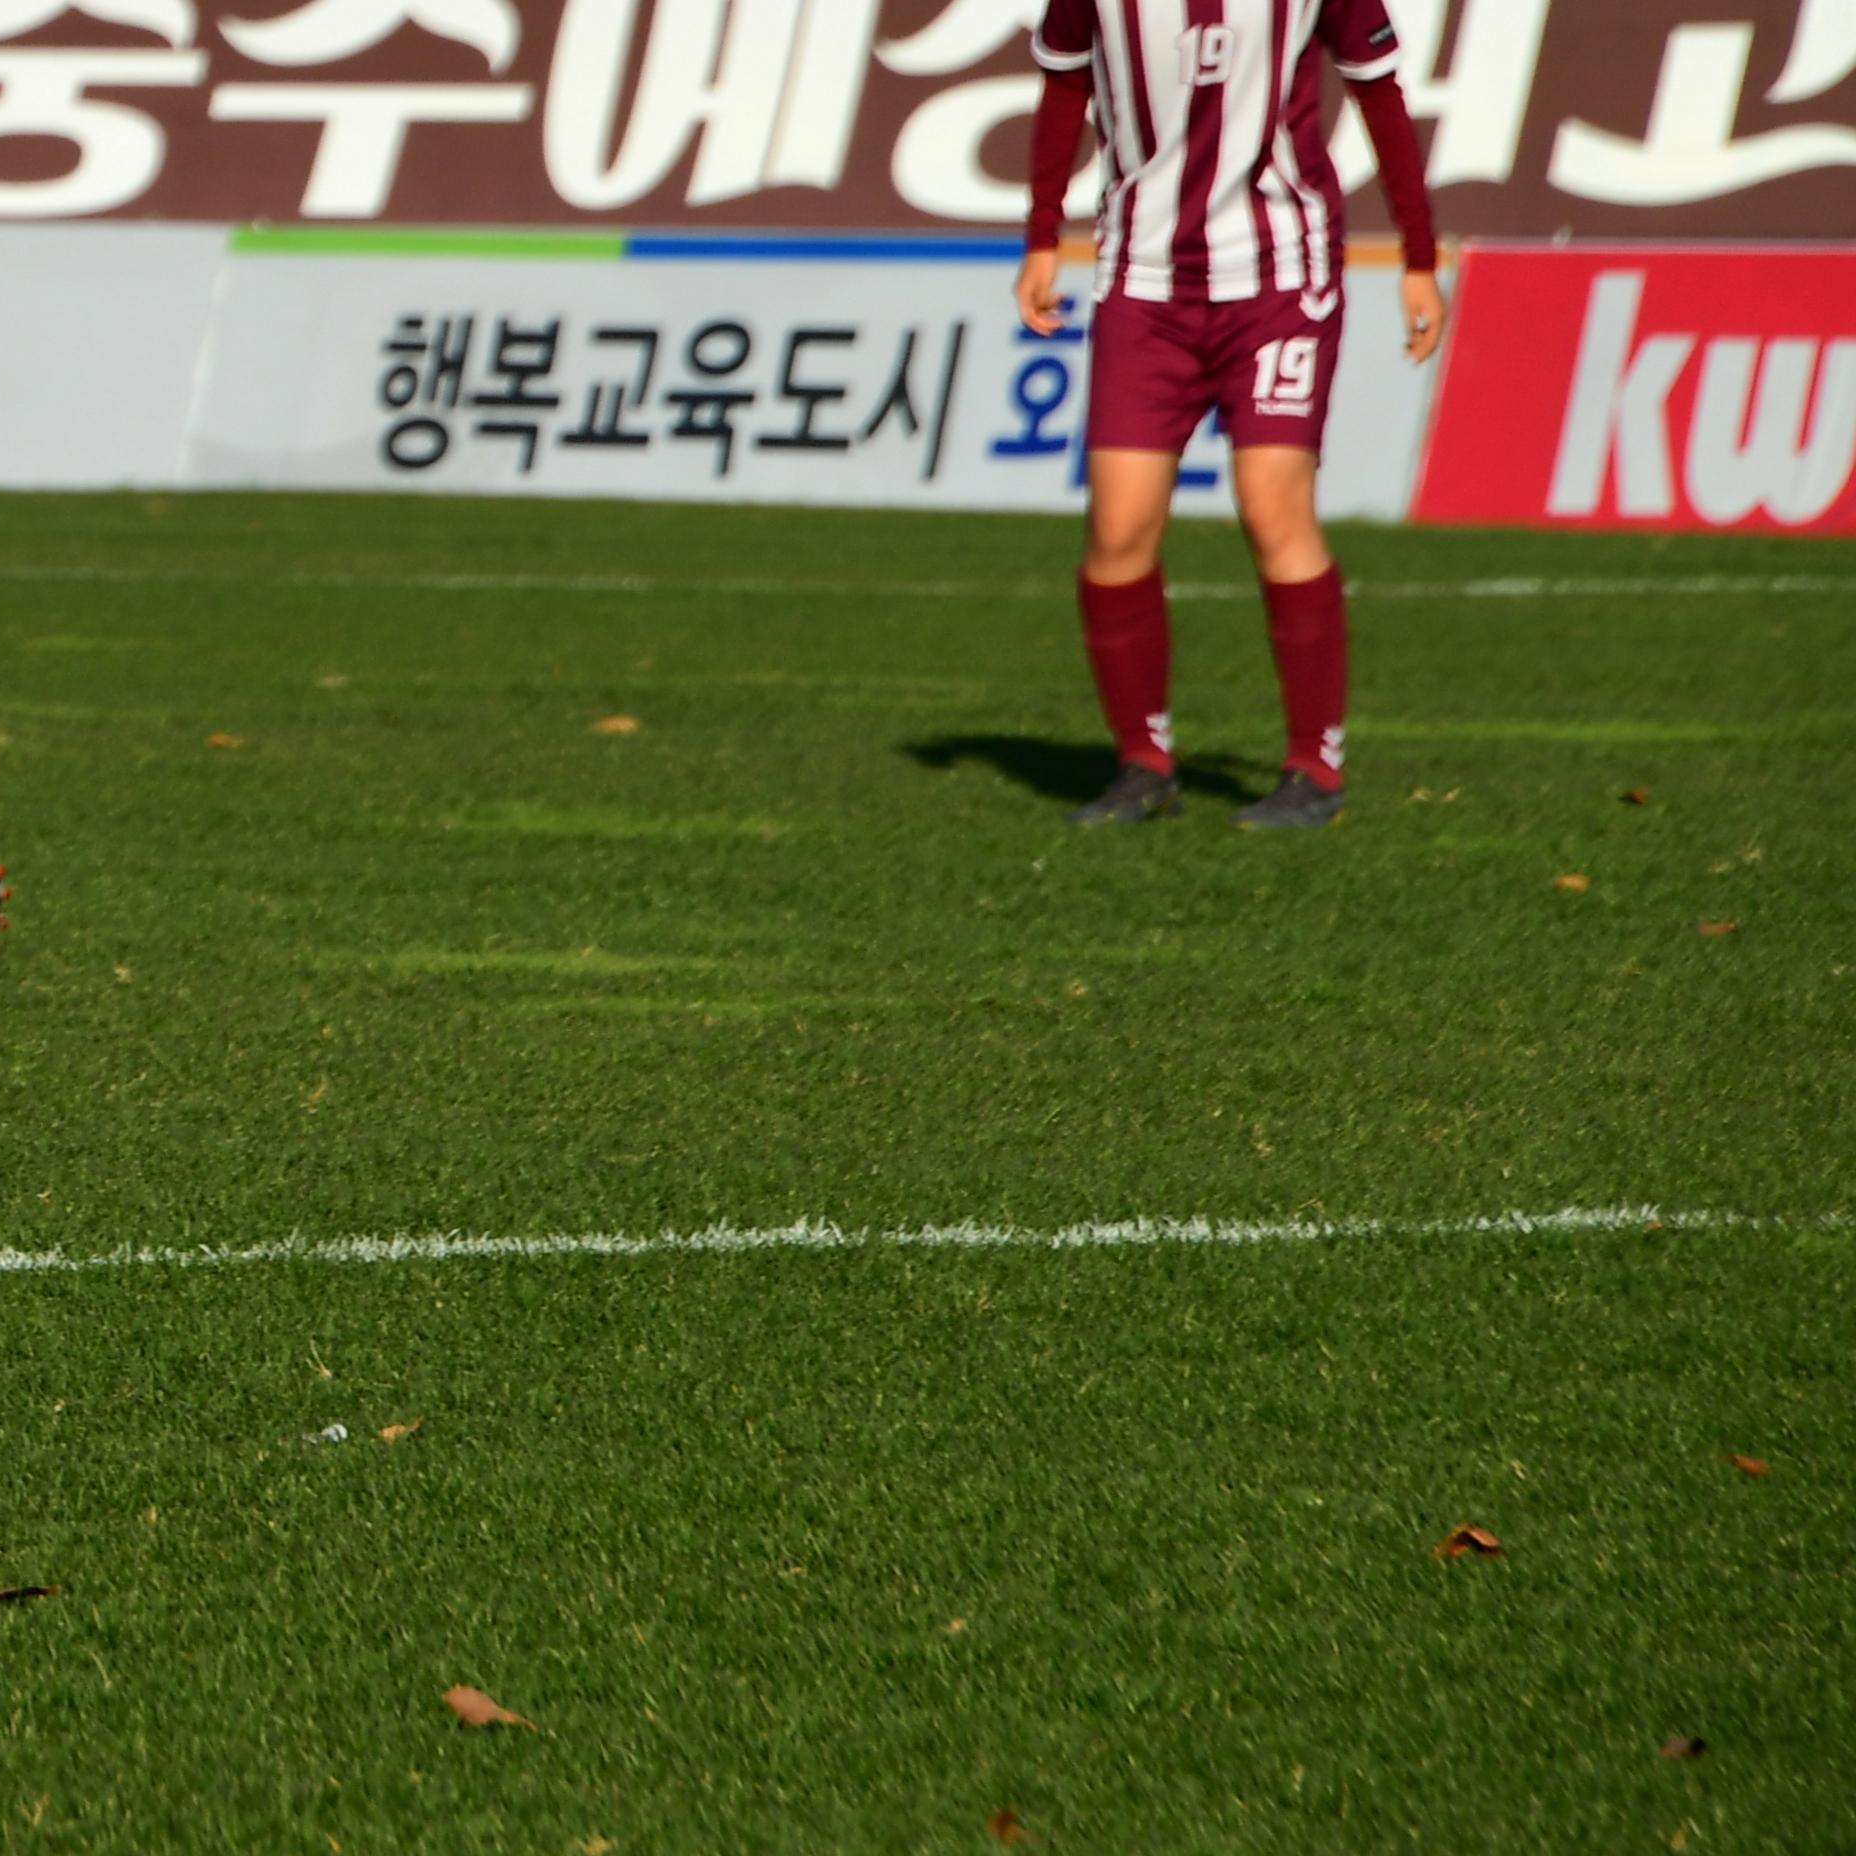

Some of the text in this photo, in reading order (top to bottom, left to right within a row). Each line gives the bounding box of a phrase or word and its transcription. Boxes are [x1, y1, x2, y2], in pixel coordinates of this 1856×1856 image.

[1176, 23, 1235, 86] 19
[380, 315, 968, 484] 행복교육도시
[1251, 335, 1319, 401] 19
[1546, 267, 1856, 526] kw
